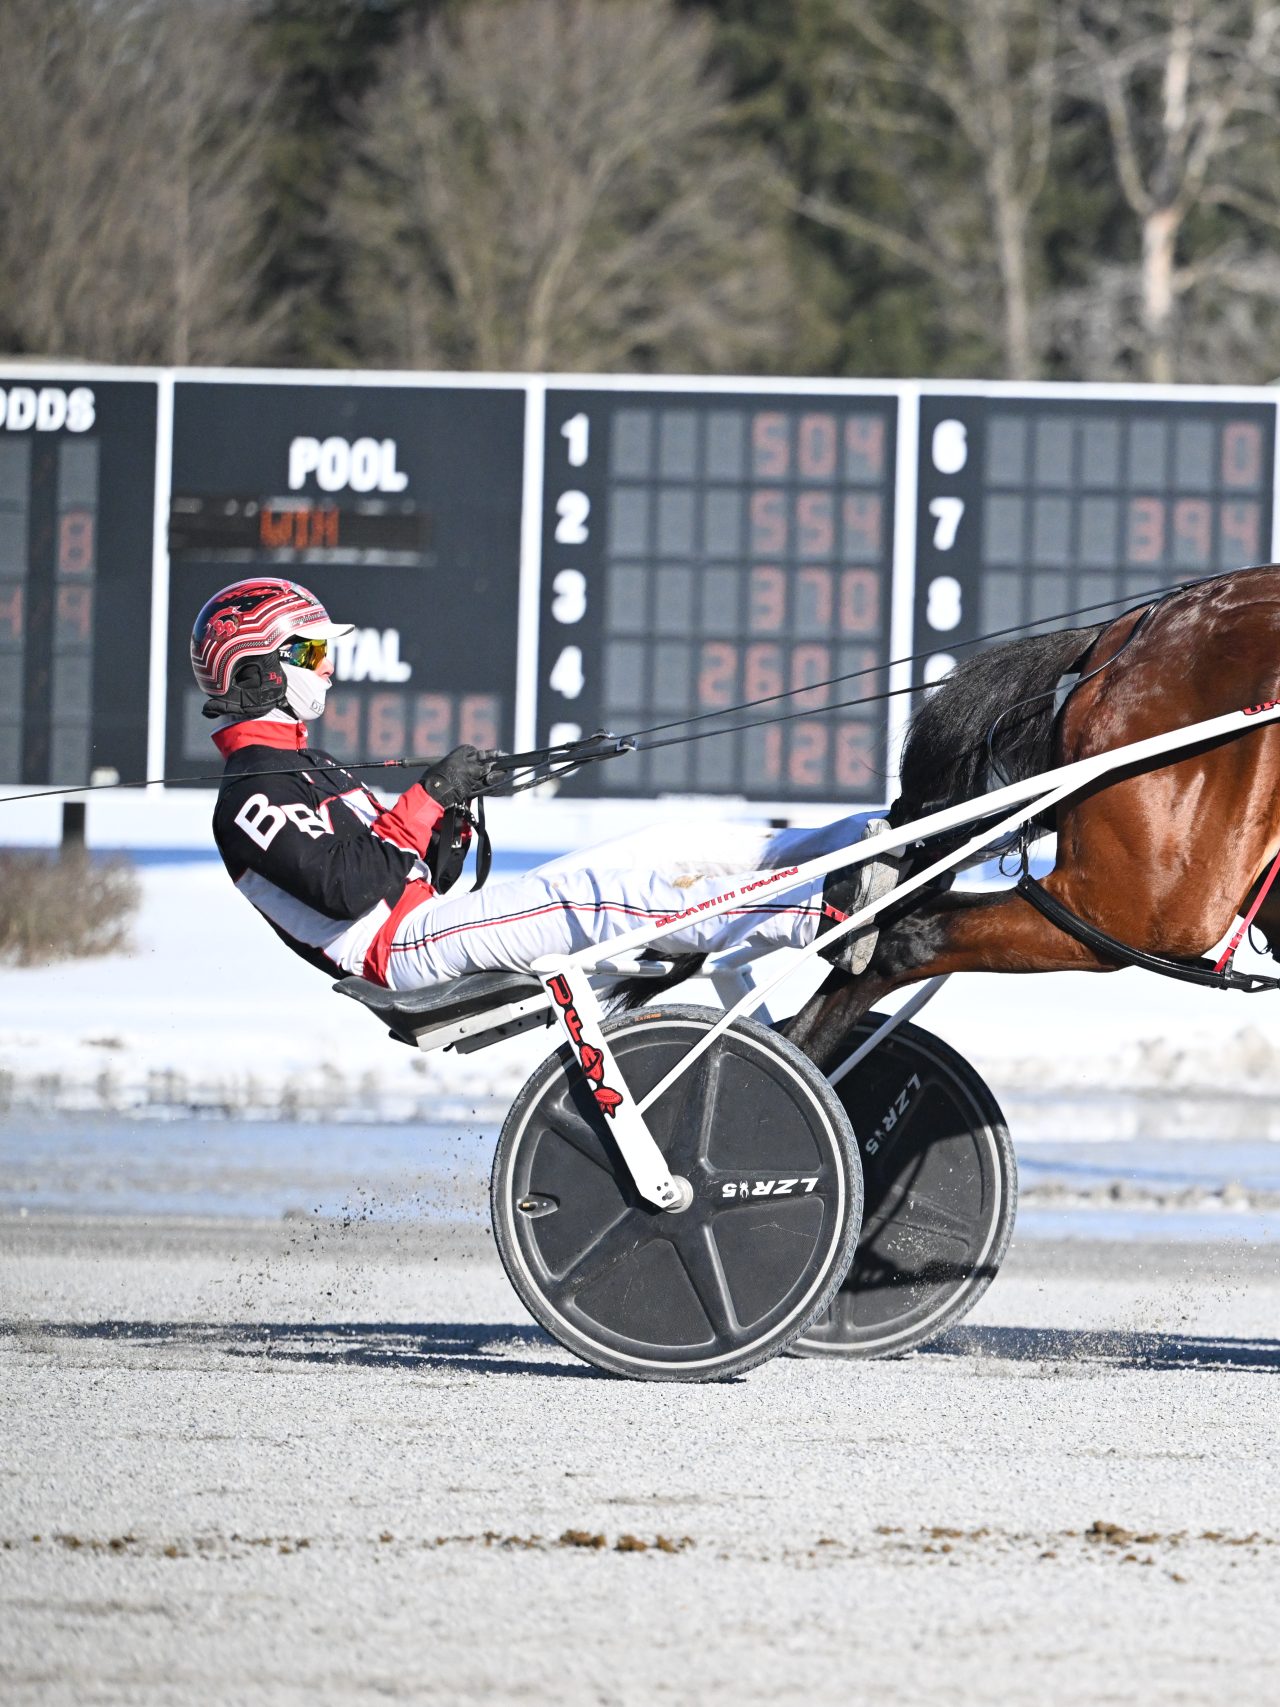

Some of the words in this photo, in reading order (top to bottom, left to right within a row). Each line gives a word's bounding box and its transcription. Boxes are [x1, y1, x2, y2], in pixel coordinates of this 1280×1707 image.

[289, 436, 408, 492] POOL
[561, 412, 589, 467] 1
[751, 411, 884, 478] 504
[932, 418, 967, 474] 6
[1222, 424, 1261, 486] 0
[555, 490, 590, 544] 2
[749, 490, 883, 555] 554
[928, 496, 965, 551] 7
[1127, 497, 1259, 562] 394
[551, 569, 586, 624] 3
[749, 566, 879, 632] 370
[926, 576, 962, 631] 8
[328, 628, 412, 682] TAL
[550, 645, 584, 699] 4
[701, 640, 877, 708] 2601
[324, 692, 498, 757] 4626
[763, 720, 876, 788] 126
